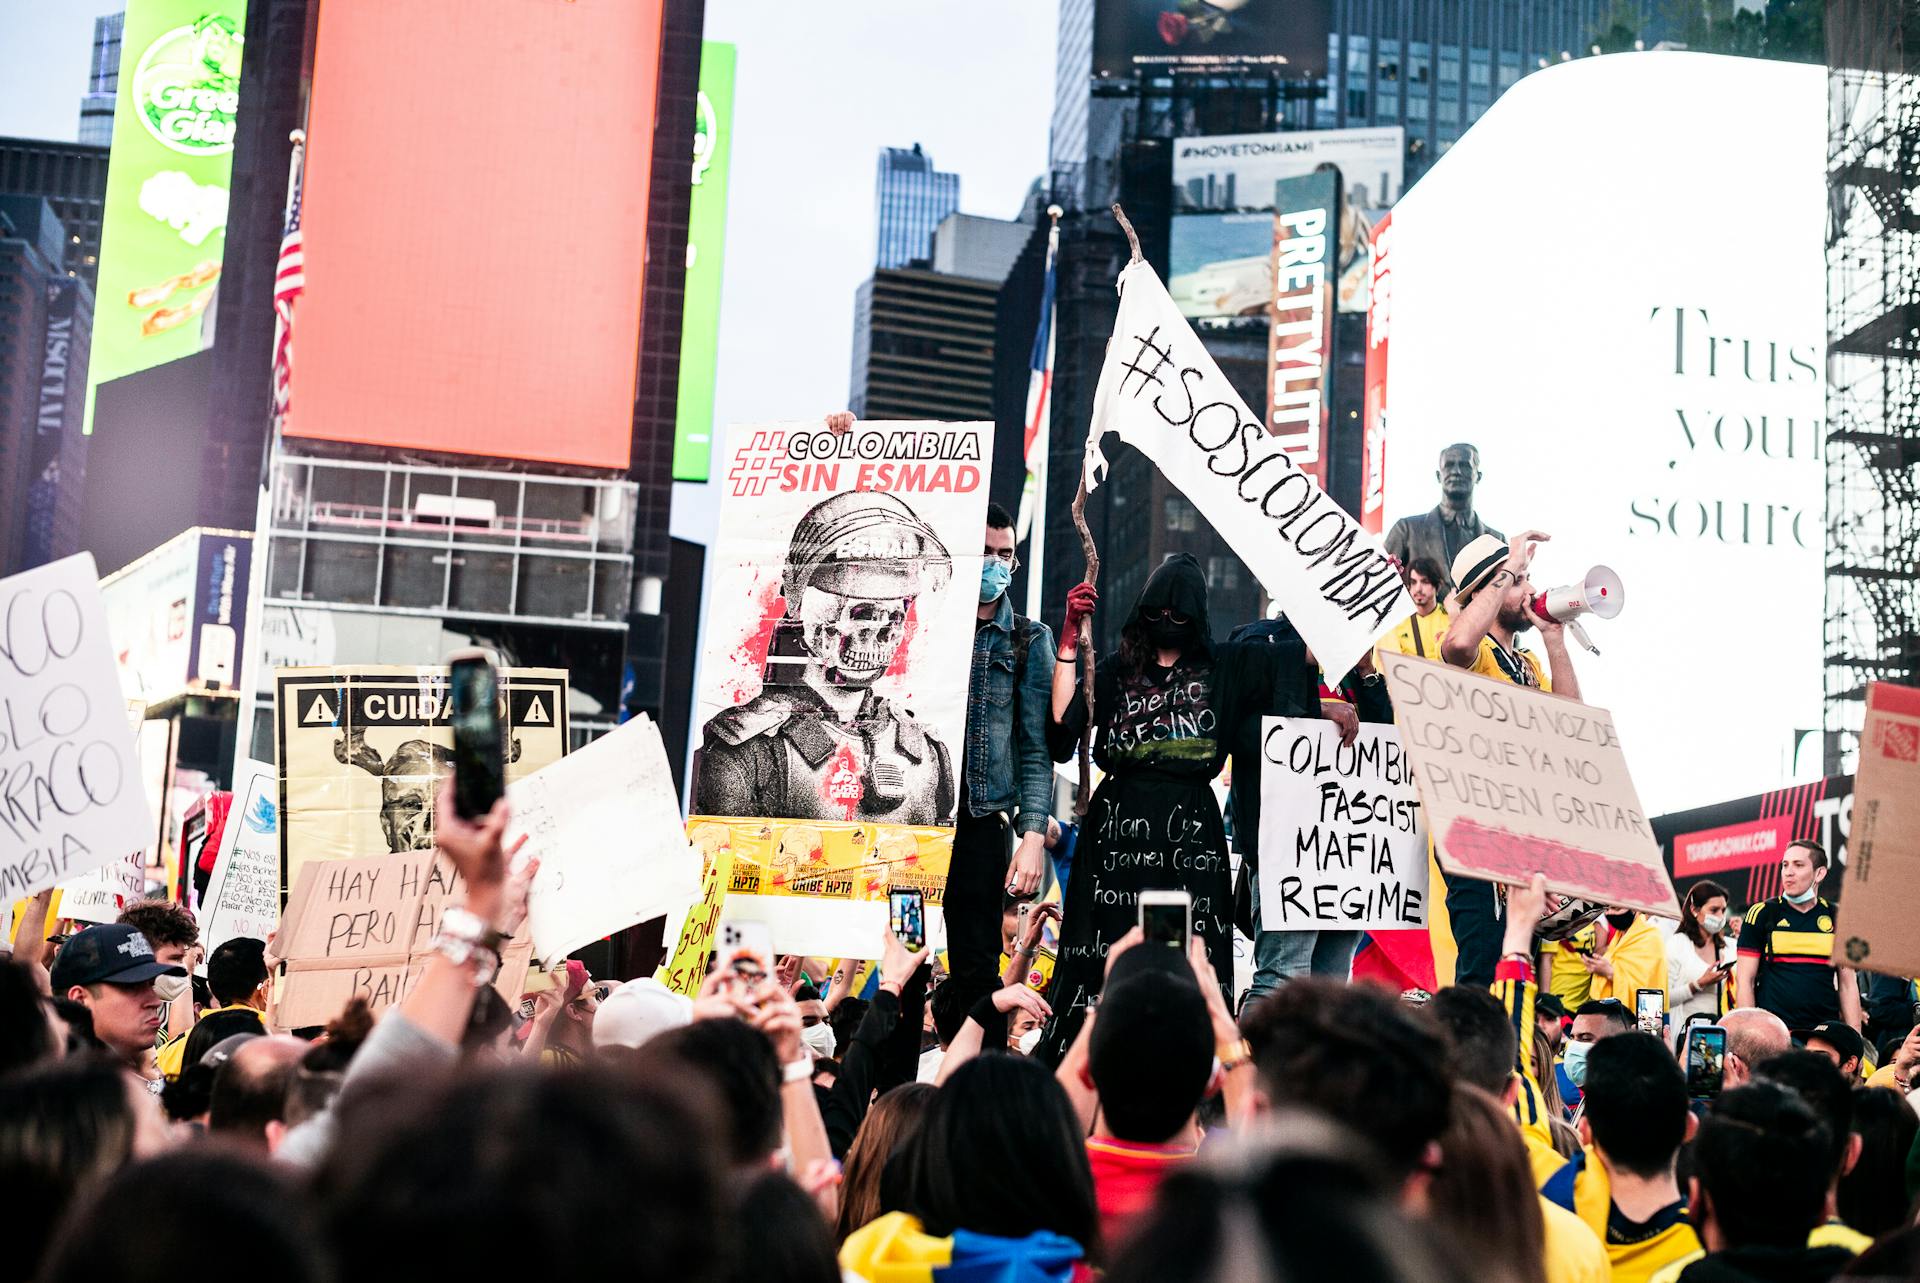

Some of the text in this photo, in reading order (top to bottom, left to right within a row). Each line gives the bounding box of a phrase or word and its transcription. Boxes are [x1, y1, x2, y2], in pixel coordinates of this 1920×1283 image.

[149, 80, 239, 114] Gree
[1650, 306, 1817, 383] Trus
[780, 463, 981, 493] SIN ESMAD
[1119, 326, 1404, 634] #SOSCOLOMBIA
[1628, 498, 1809, 551] sourc
[0, 588, 83, 677] CO
[0, 682, 90, 752] LO
[1105, 708, 1216, 757] ASESINO
[1406, 716, 1463, 754] LOS
[1468, 733, 1519, 767] QUE
[1563, 757, 1602, 786] NO
[1316, 781, 1421, 835] FASCIST
[1424, 762, 1649, 839] PUEDEN GRITAR
[1295, 824, 1395, 875] MAFIA
[329, 865, 380, 904] HAY
[733, 876, 760, 889] HPTA
[825, 880, 853, 894] HPTA
[1279, 875, 1422, 924] REGIME
[326, 908, 396, 957] PERO
